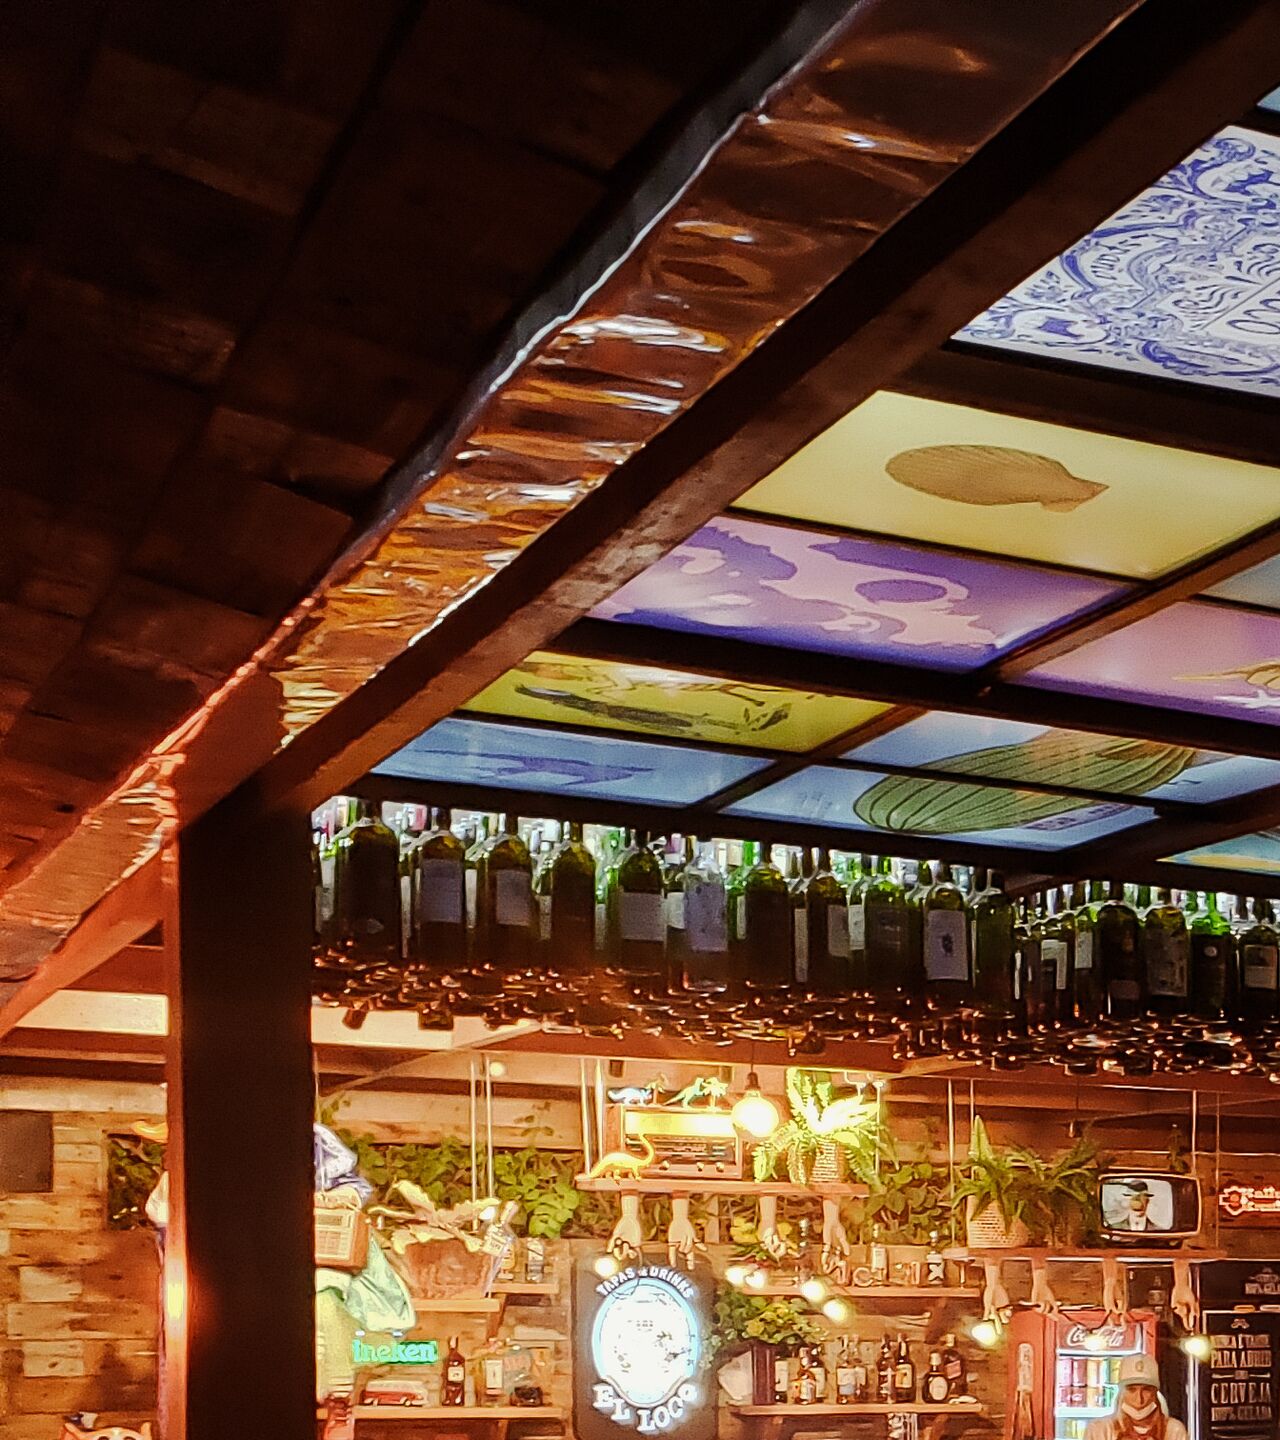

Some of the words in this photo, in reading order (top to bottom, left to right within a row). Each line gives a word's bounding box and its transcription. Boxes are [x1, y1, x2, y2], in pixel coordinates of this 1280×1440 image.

[595, 1266, 636, 1296] TAPAS
[649, 1265, 696, 1299] DRINKS
[1210, 1350, 1238, 1369] PARA
[1210, 1382, 1272, 1405] CERVEJA
[593, 1383, 631, 1421] EL
[636, 1383, 698, 1432] LOCO
[1237, 1405, 1272, 1421] GELADA
